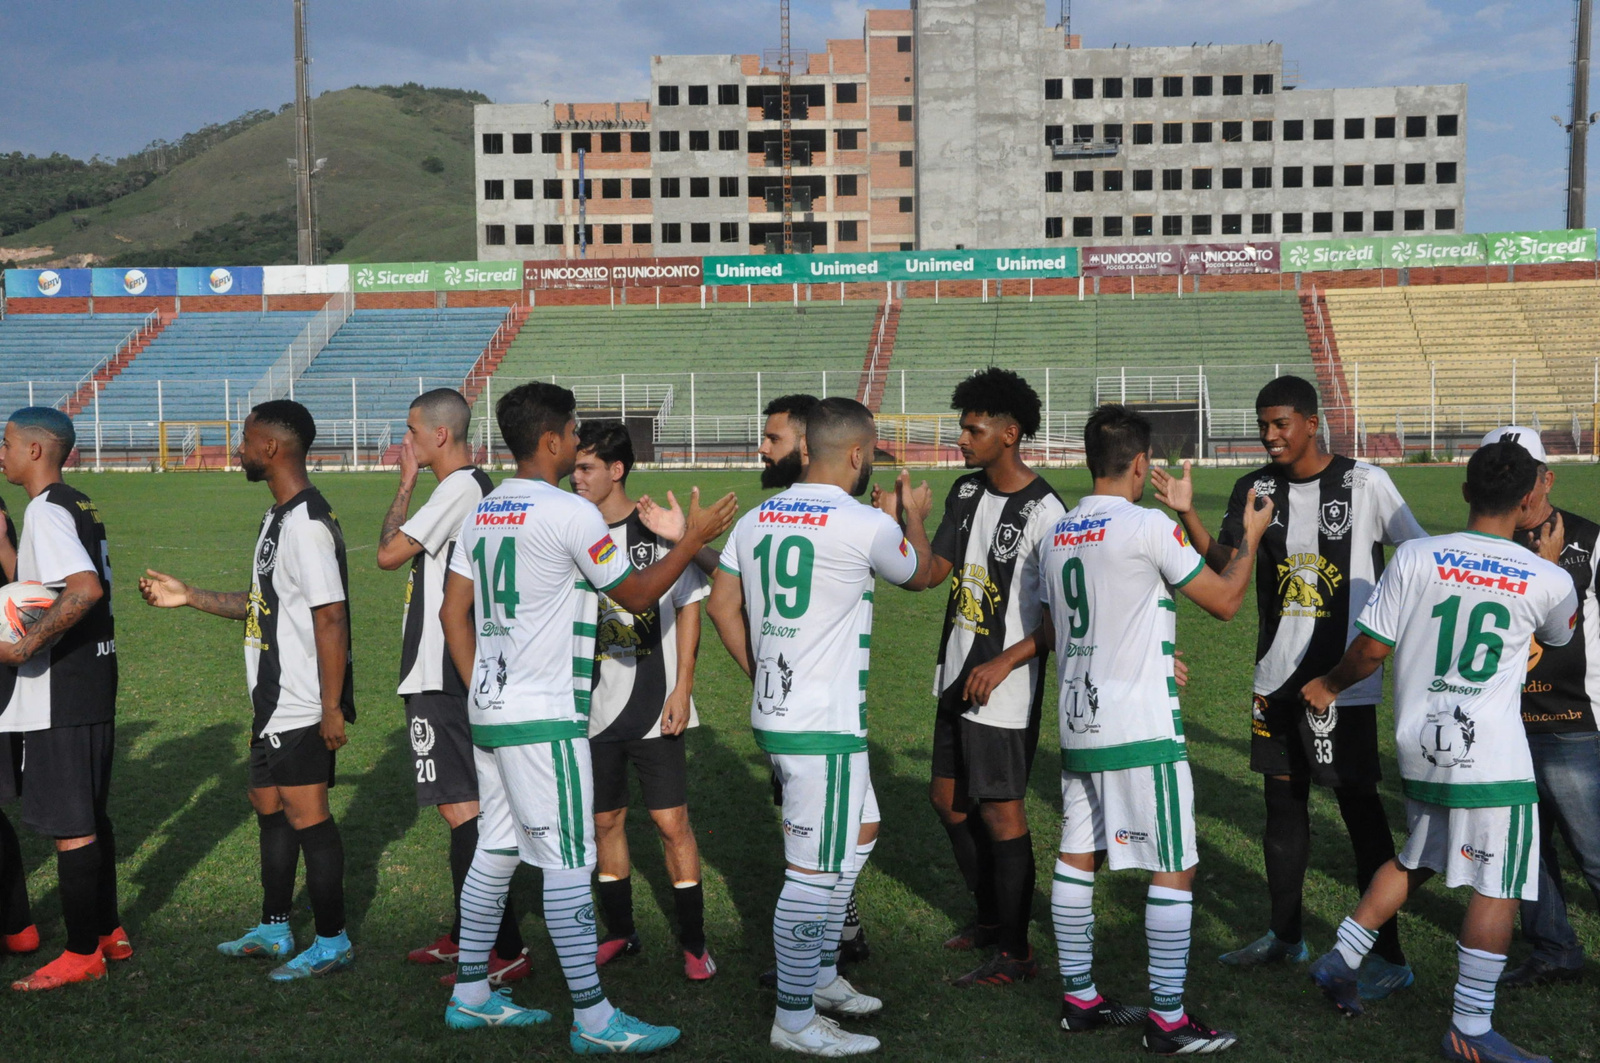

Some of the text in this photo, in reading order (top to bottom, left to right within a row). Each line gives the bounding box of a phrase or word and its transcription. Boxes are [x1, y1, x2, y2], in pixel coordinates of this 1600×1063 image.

[1313, 245, 1373, 263] Sicredi
[1415, 242, 1478, 259] Sicredi
[1520, 237, 1587, 256] Sicredi
[996, 256, 1066, 271] Unimed
[1101, 252, 1172, 264] UNIODONTO
[1201, 250, 1273, 262] UNIODONTO
[540, 267, 608, 280] UNIODONTO
[627, 265, 700, 278] UNIODONTO
[716, 263, 783, 278] Unimed
[810, 261, 878, 276] Unimed
[905, 258, 974, 273] Unimed
[42, 274, 60, 290] EPTV
[128, 273, 146, 289] EPTV
[214, 272, 232, 288] EPTV
[377, 269, 429, 285] Sicredi
[464, 268, 517, 283] Sicredi
[477, 500, 535, 513] Walter
[760, 500, 837, 513] Walter
[475, 512, 527, 526] World
[758, 511, 828, 527] World
[1055, 518, 1112, 534] Walter
[1053, 528, 1106, 547] World
[1276, 553, 1343, 588] AVIDBEL
[1433, 552, 1536, 581] Walter
[472, 536, 520, 619] 14
[753, 534, 815, 619] 19
[1437, 566, 1528, 595] World
[951, 563, 1002, 608] DVIDBEL
[1062, 557, 1089, 639] 9
[762, 621, 798, 638] Duson
[1431, 594, 1511, 683] 16
[764, 671, 774, 699] L
[1428, 679, 1482, 696] Duson
[1073, 691, 1083, 718] L
[1434, 725, 1452, 751] L
[1314, 738, 1334, 764] 33
[415, 759, 437, 783] 20
